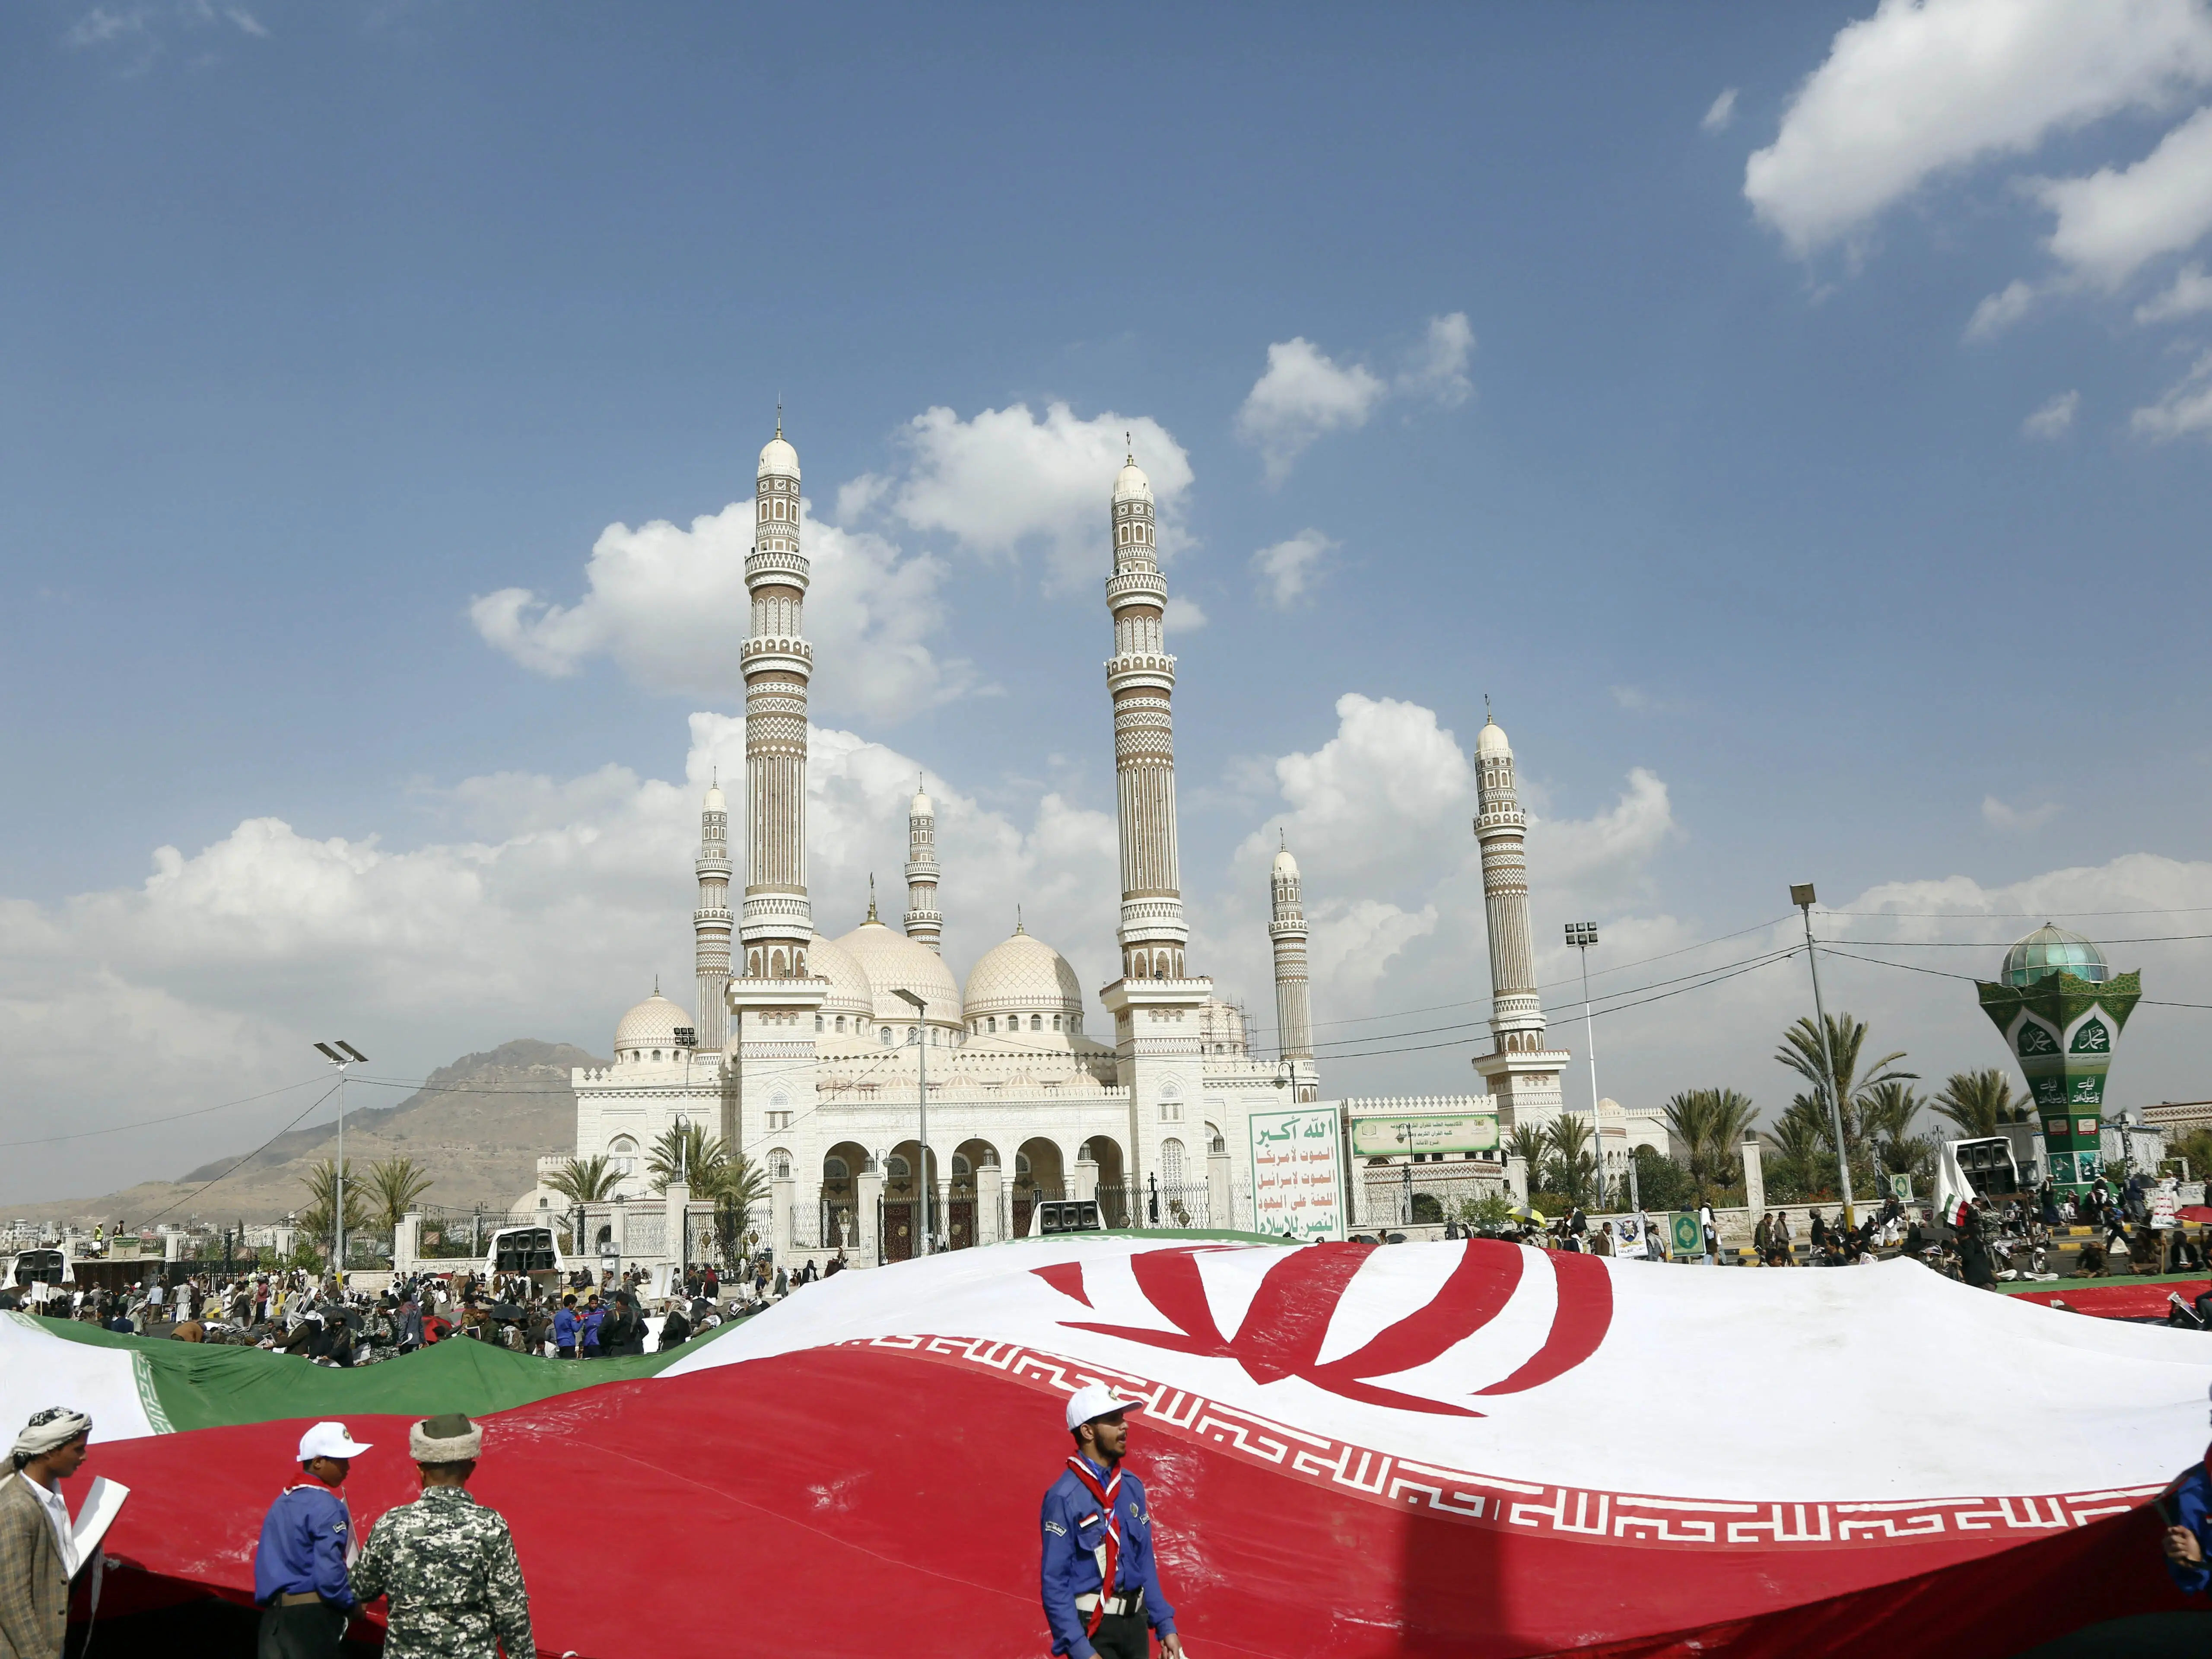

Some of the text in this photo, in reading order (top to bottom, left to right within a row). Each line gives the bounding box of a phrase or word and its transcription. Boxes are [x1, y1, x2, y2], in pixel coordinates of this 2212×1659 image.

[1255, 1116, 1333, 1147] الله أكبر
[1256, 1145, 1334, 1166] الموت لأمريكا
[1258, 1169, 1335, 1190] الموت لإسرائيل
[1258, 1192, 1337, 1212] اللعنة على اليهود
[1303, 1211, 1338, 1238] النصر
